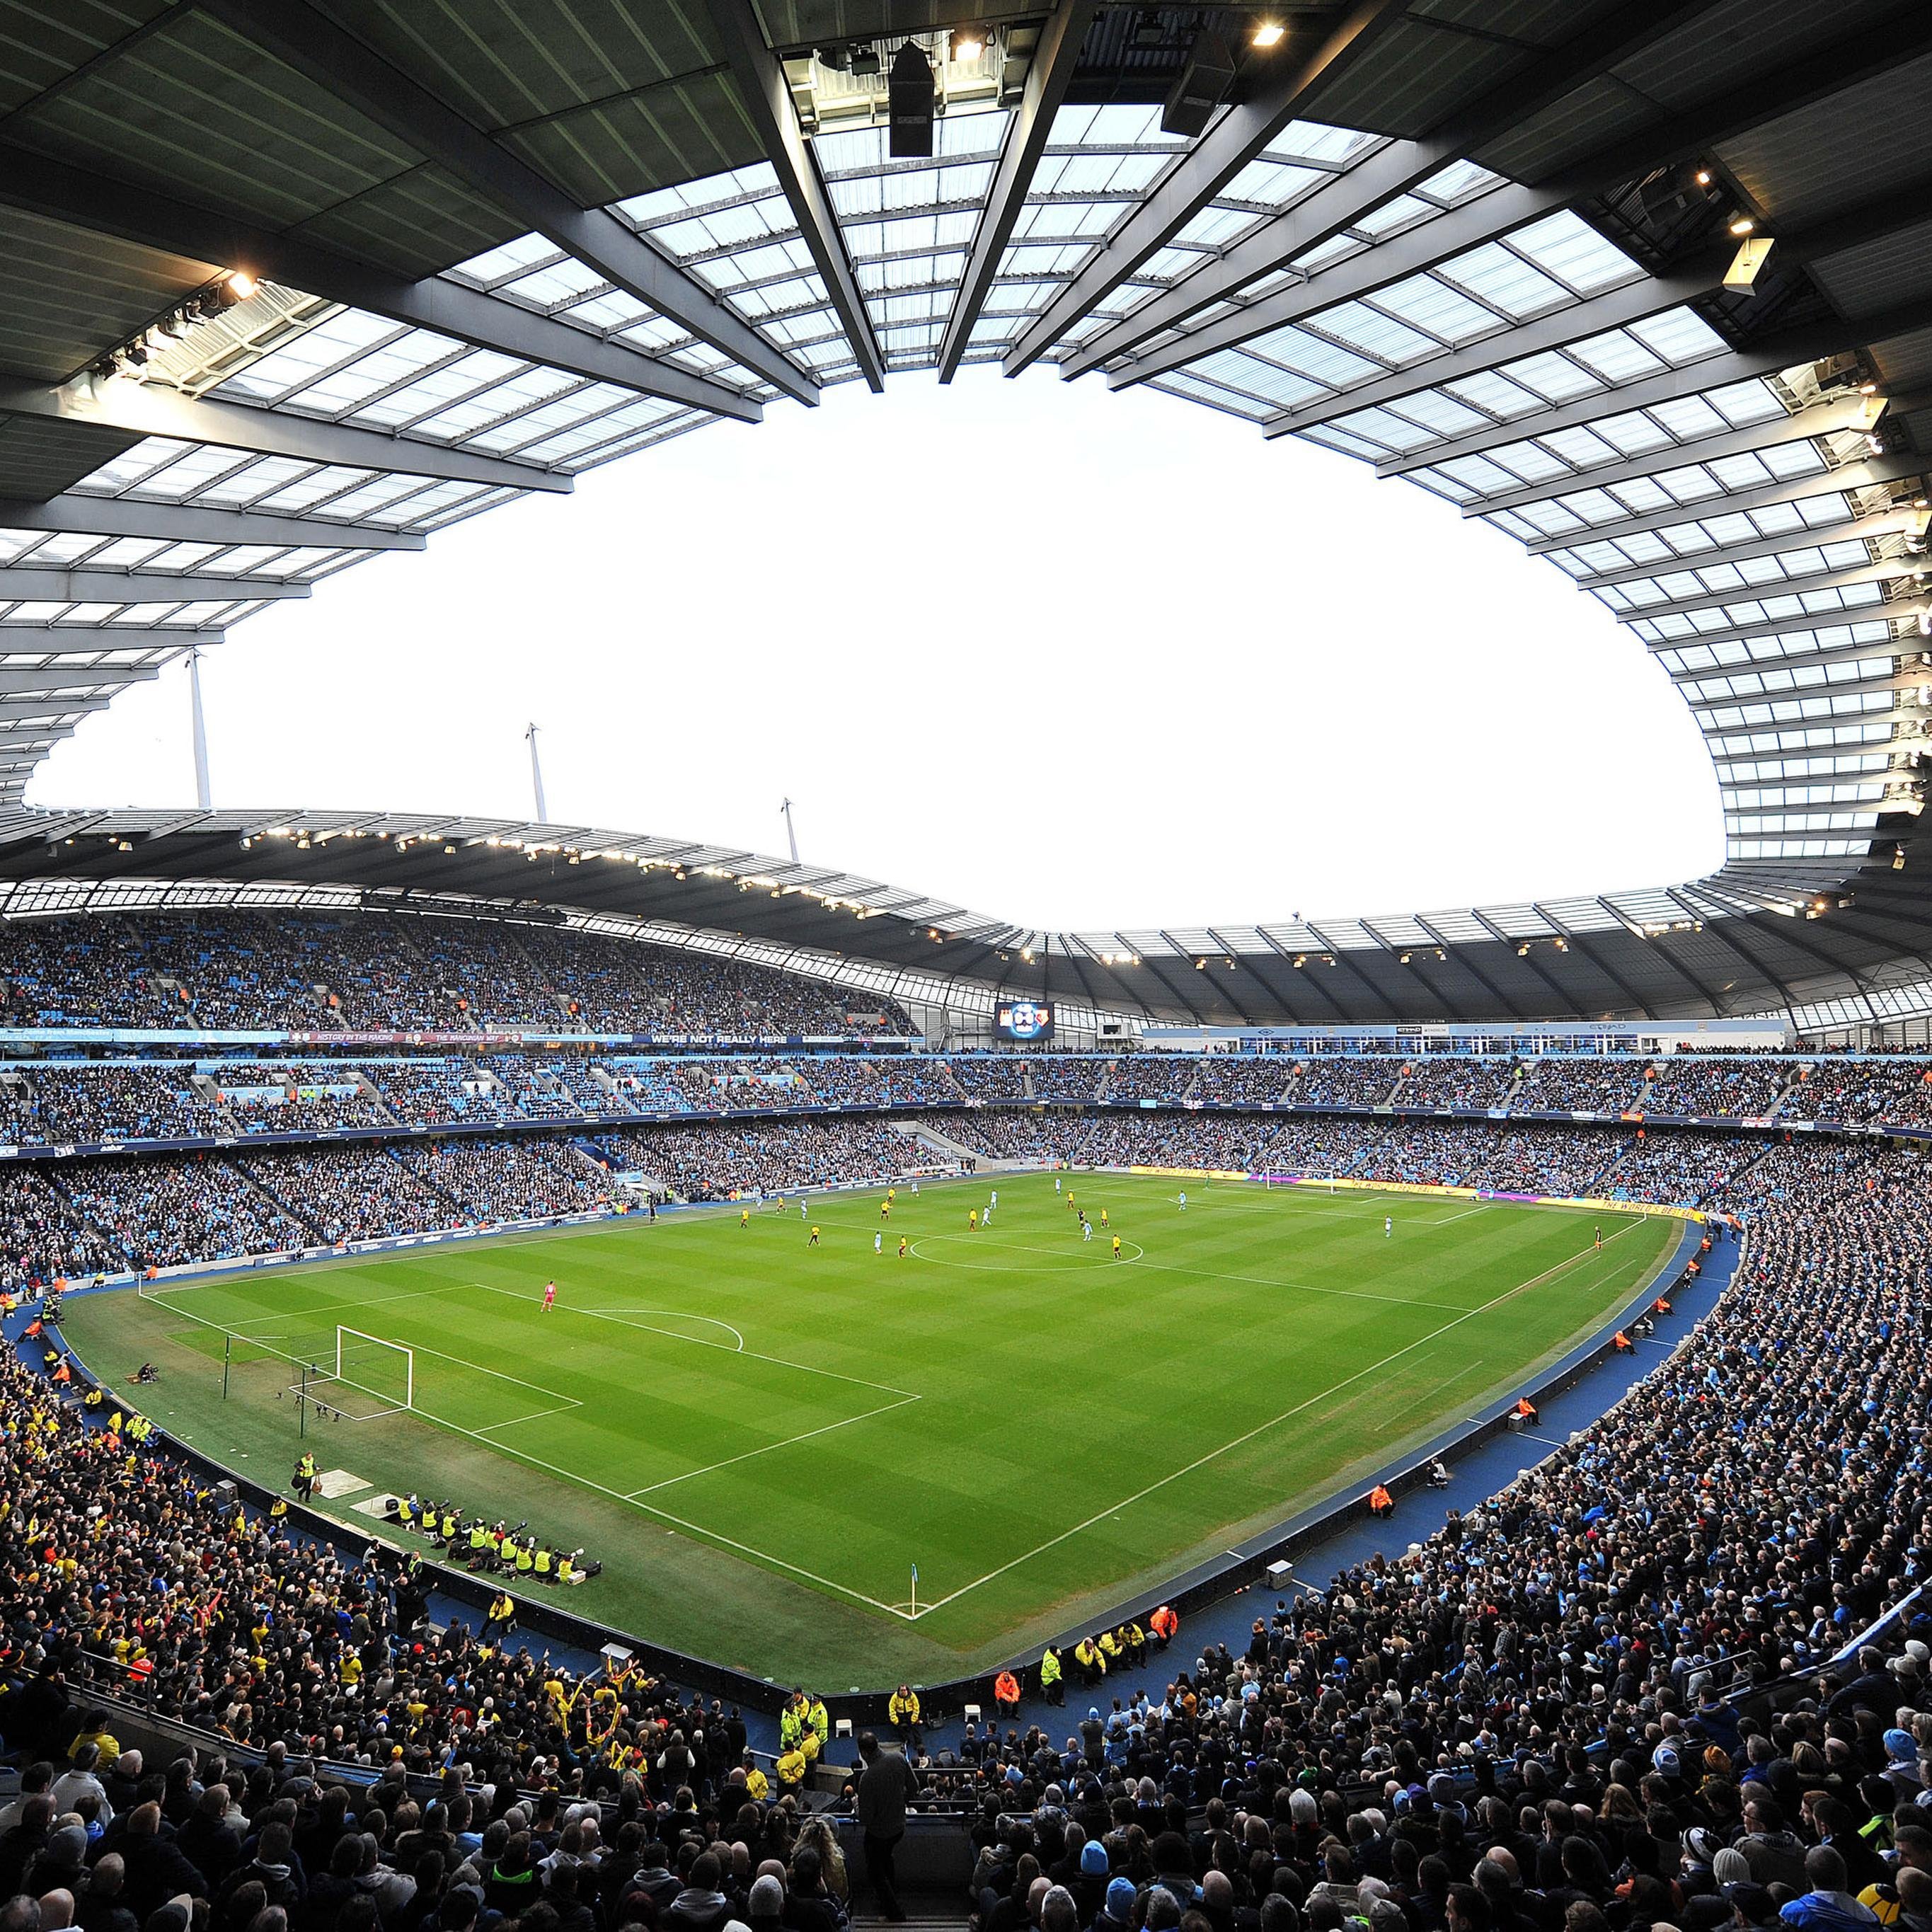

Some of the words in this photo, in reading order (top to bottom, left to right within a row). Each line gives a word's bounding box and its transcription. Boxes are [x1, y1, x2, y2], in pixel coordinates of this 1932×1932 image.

[651, 1035, 687, 1043] WE'RE
[1602, 1201, 1618, 1209] THE
[1620, 1202, 1660, 1214] WORLD'S
[1661, 1207, 1681, 1217] BEST
